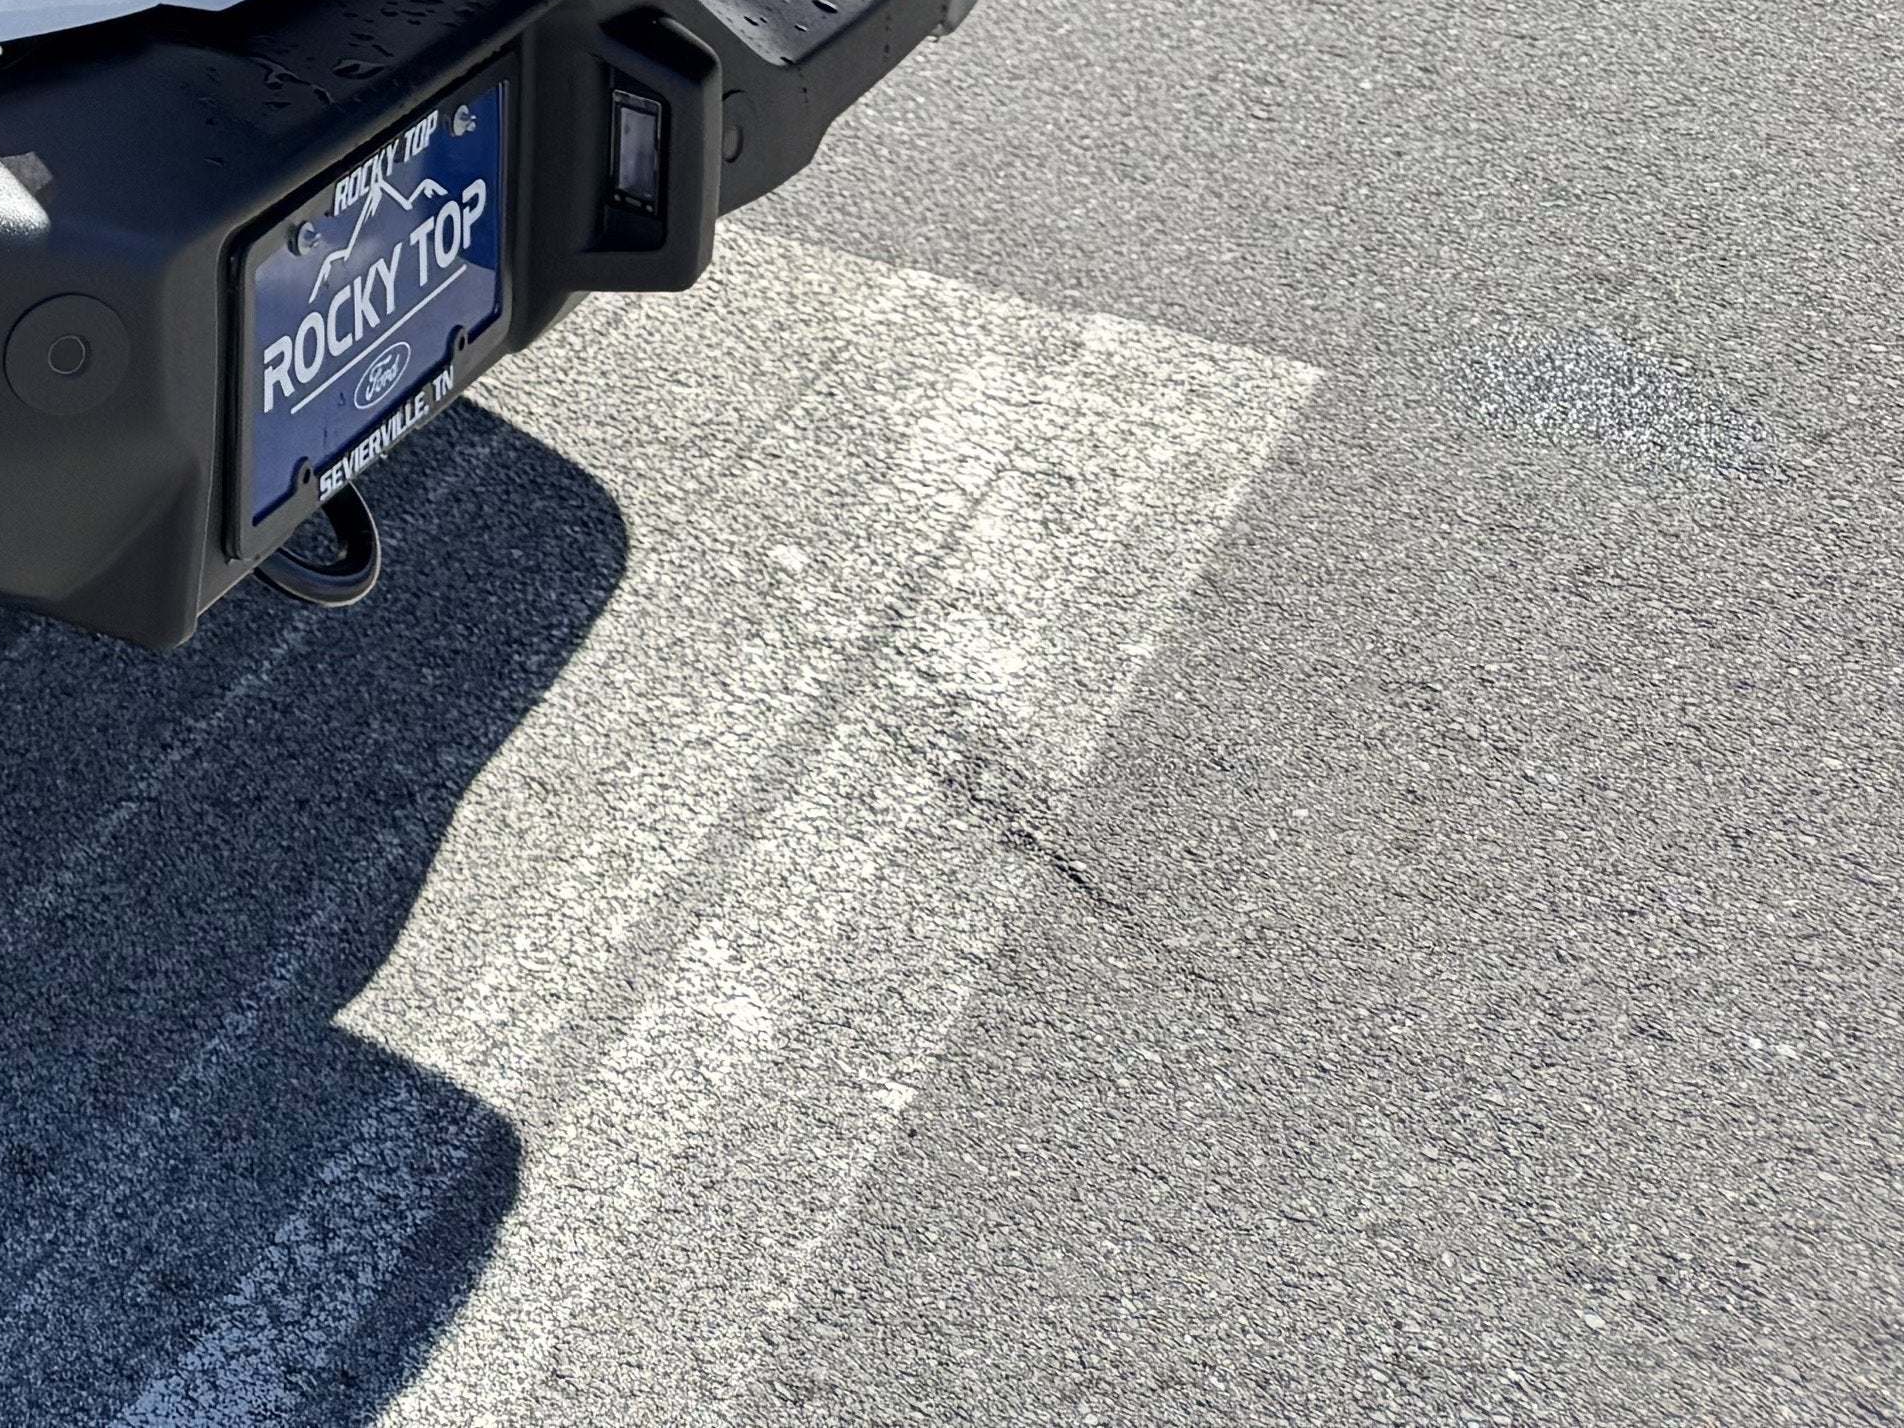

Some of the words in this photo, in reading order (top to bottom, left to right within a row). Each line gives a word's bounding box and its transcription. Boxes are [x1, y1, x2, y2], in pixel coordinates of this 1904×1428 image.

[334, 139, 399, 216] ROCKY
[404, 110, 438, 163] TOP
[263, 242, 403, 413] ROCKY
[410, 179, 486, 286] TOP
[365, 354, 400, 401] Ford
[433, 365, 454, 401] TN
